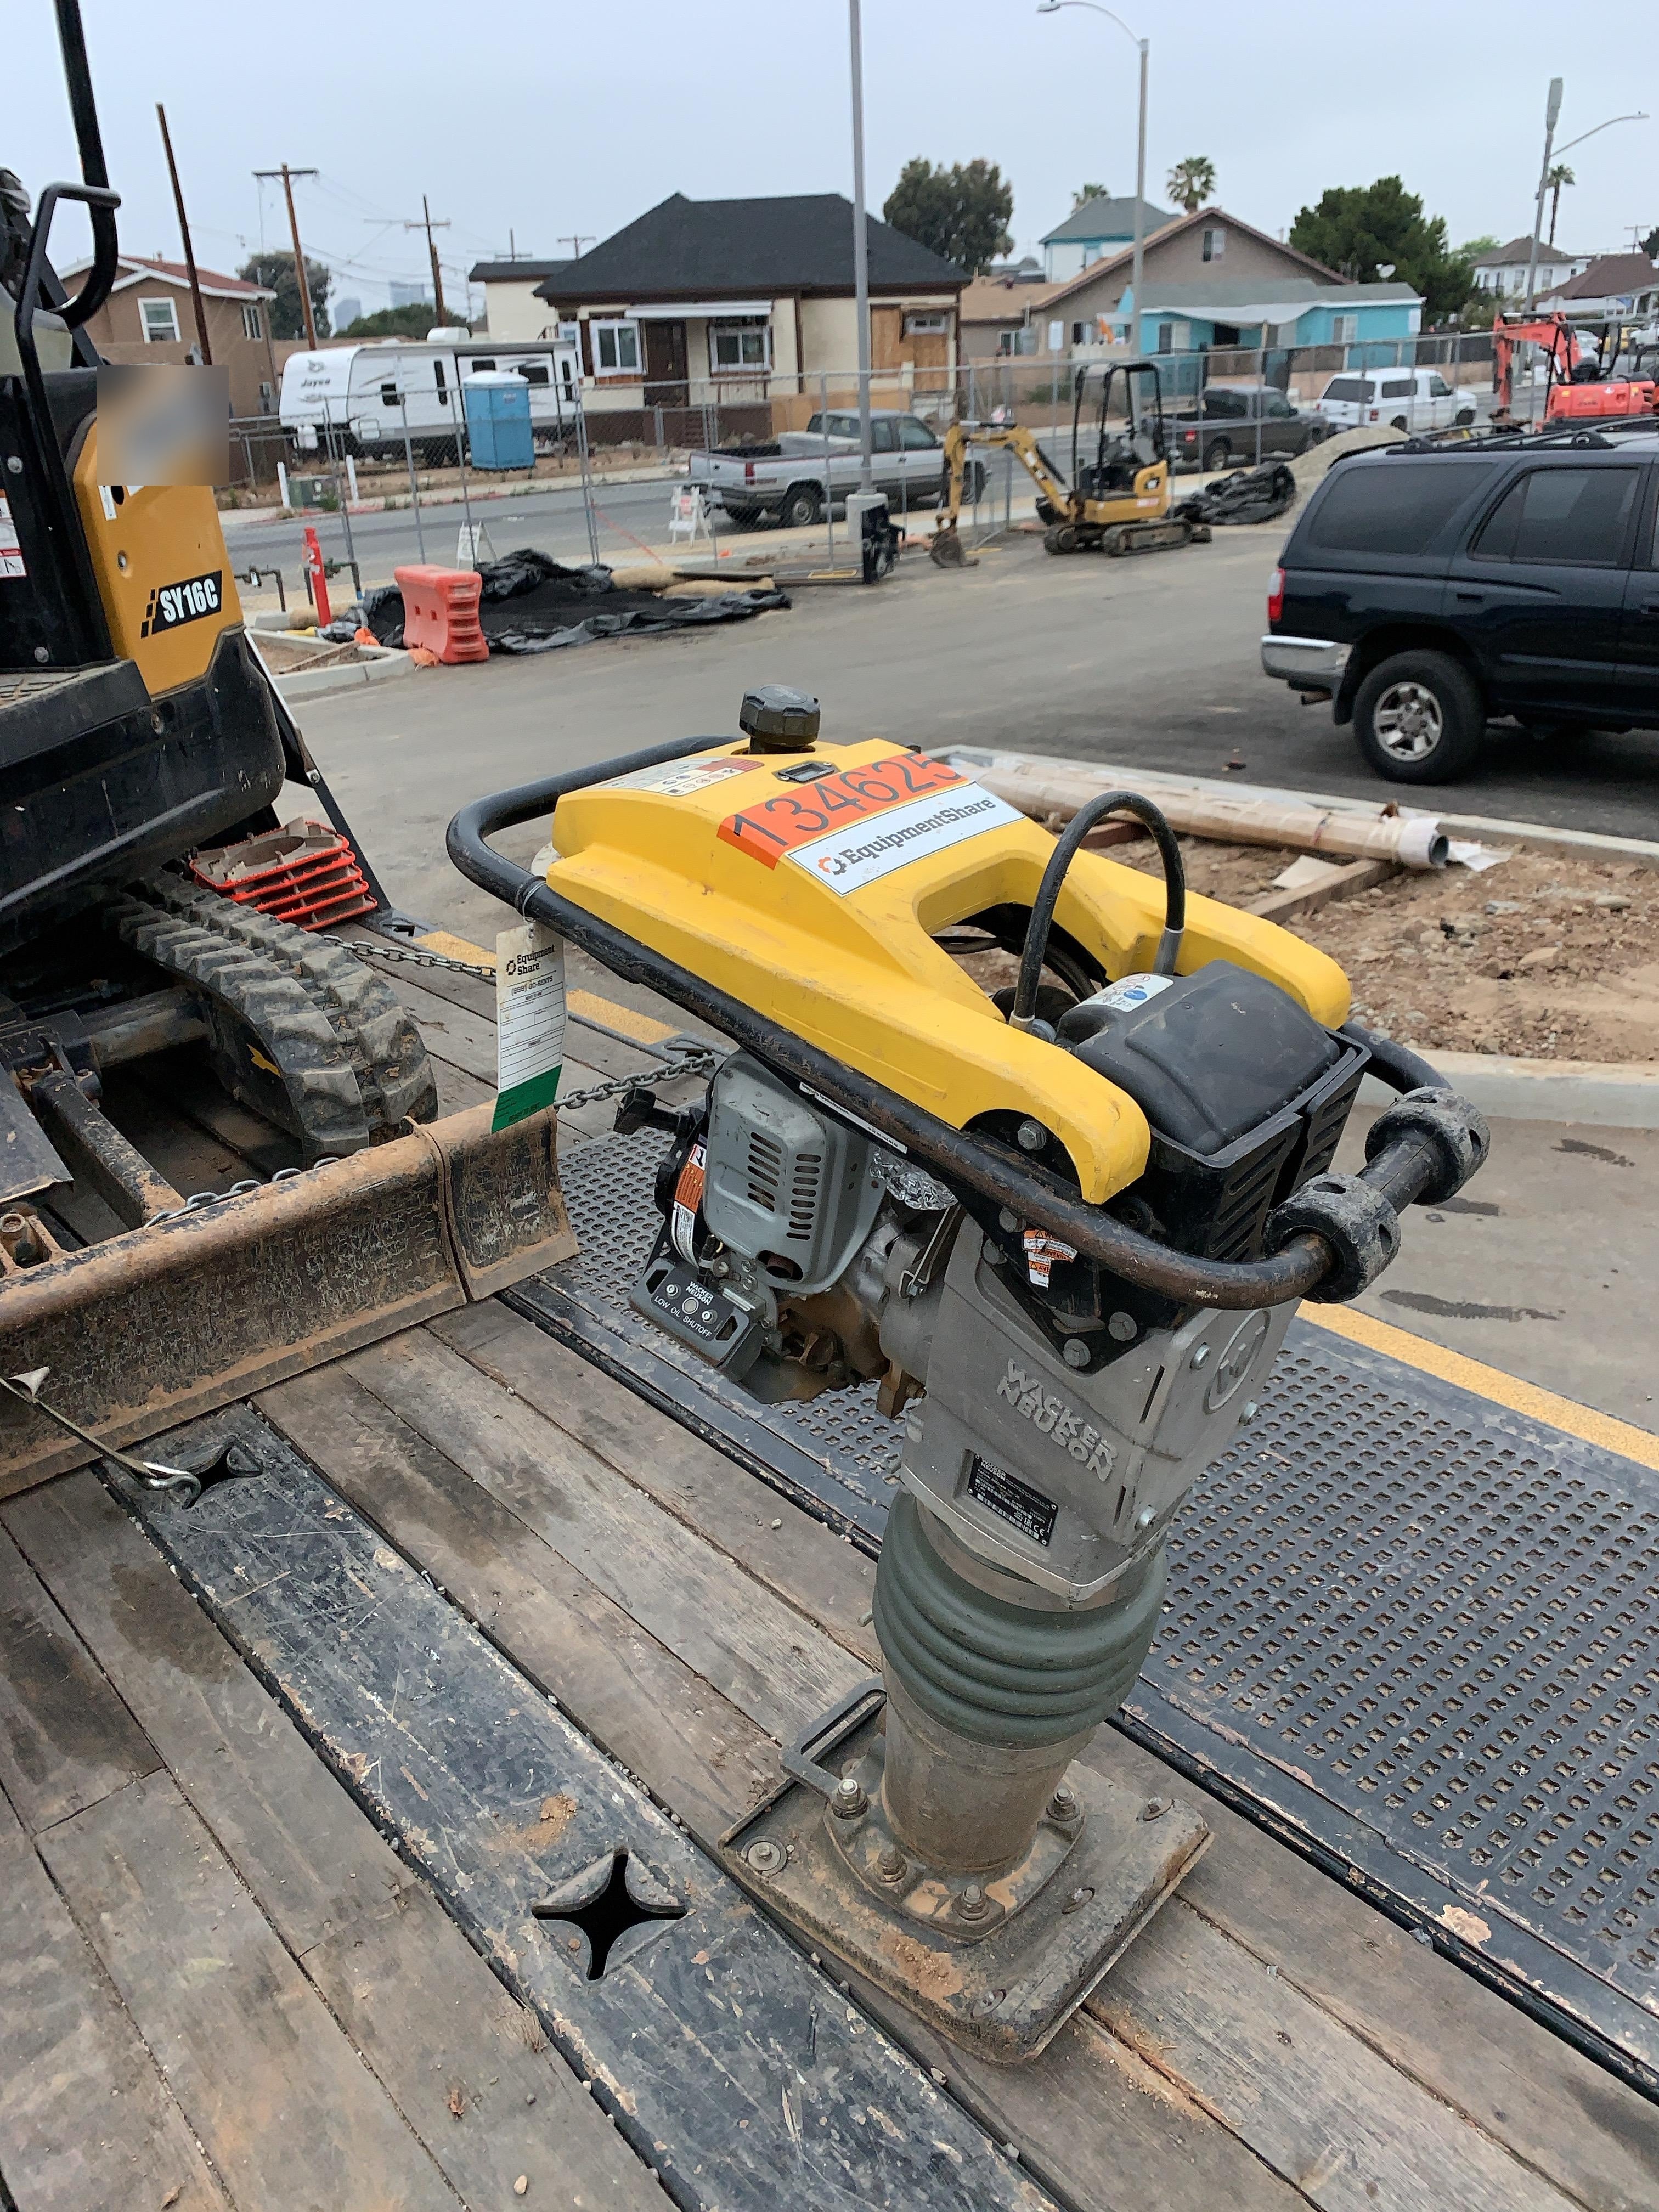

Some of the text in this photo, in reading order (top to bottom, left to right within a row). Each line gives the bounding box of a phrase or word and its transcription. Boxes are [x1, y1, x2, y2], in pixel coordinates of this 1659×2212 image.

[160, 578, 218, 623] SY16C
[733, 751, 962, 847] 134625
[839, 798, 997, 866] EquipmentShare
[517, 944, 556, 964] Equipment
[517, 962, 540, 975] Share
[686, 1285, 713, 1306] NEUSON
[690, 1280, 714, 1301] WACKER
[654, 1295, 713, 1338] LOW OIL SHUTOFF
[996, 1376, 1114, 1482] NEUSON
[1007, 1358, 1118, 1467] WACKER
[980, 1462, 1006, 1481] NEUSON
